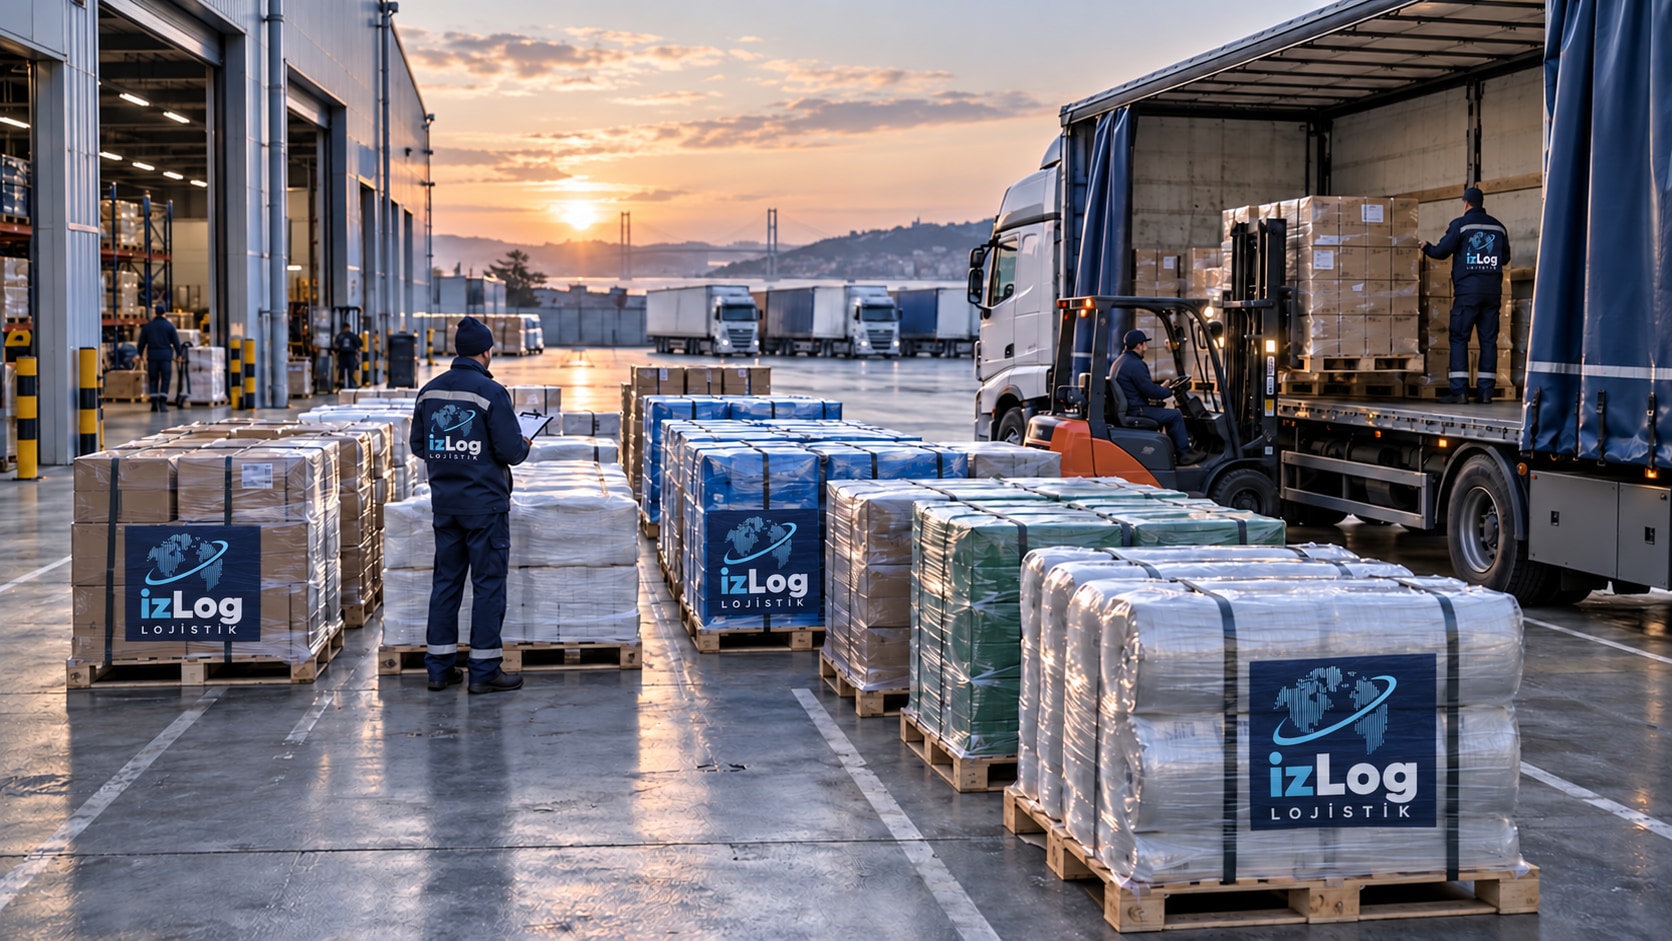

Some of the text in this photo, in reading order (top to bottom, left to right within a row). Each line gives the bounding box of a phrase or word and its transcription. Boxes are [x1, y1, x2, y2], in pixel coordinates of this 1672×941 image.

[429, 433, 481, 455] izLog
[721, 567, 808, 598] izLog
[140, 588, 243, 625] izLog
[721, 597, 804, 609] LOJİSTİK
[141, 623, 237, 635] LOJİSTİK
[1268, 751, 1418, 803] izLog
[1270, 802, 1411, 820] LOJİSTİK
